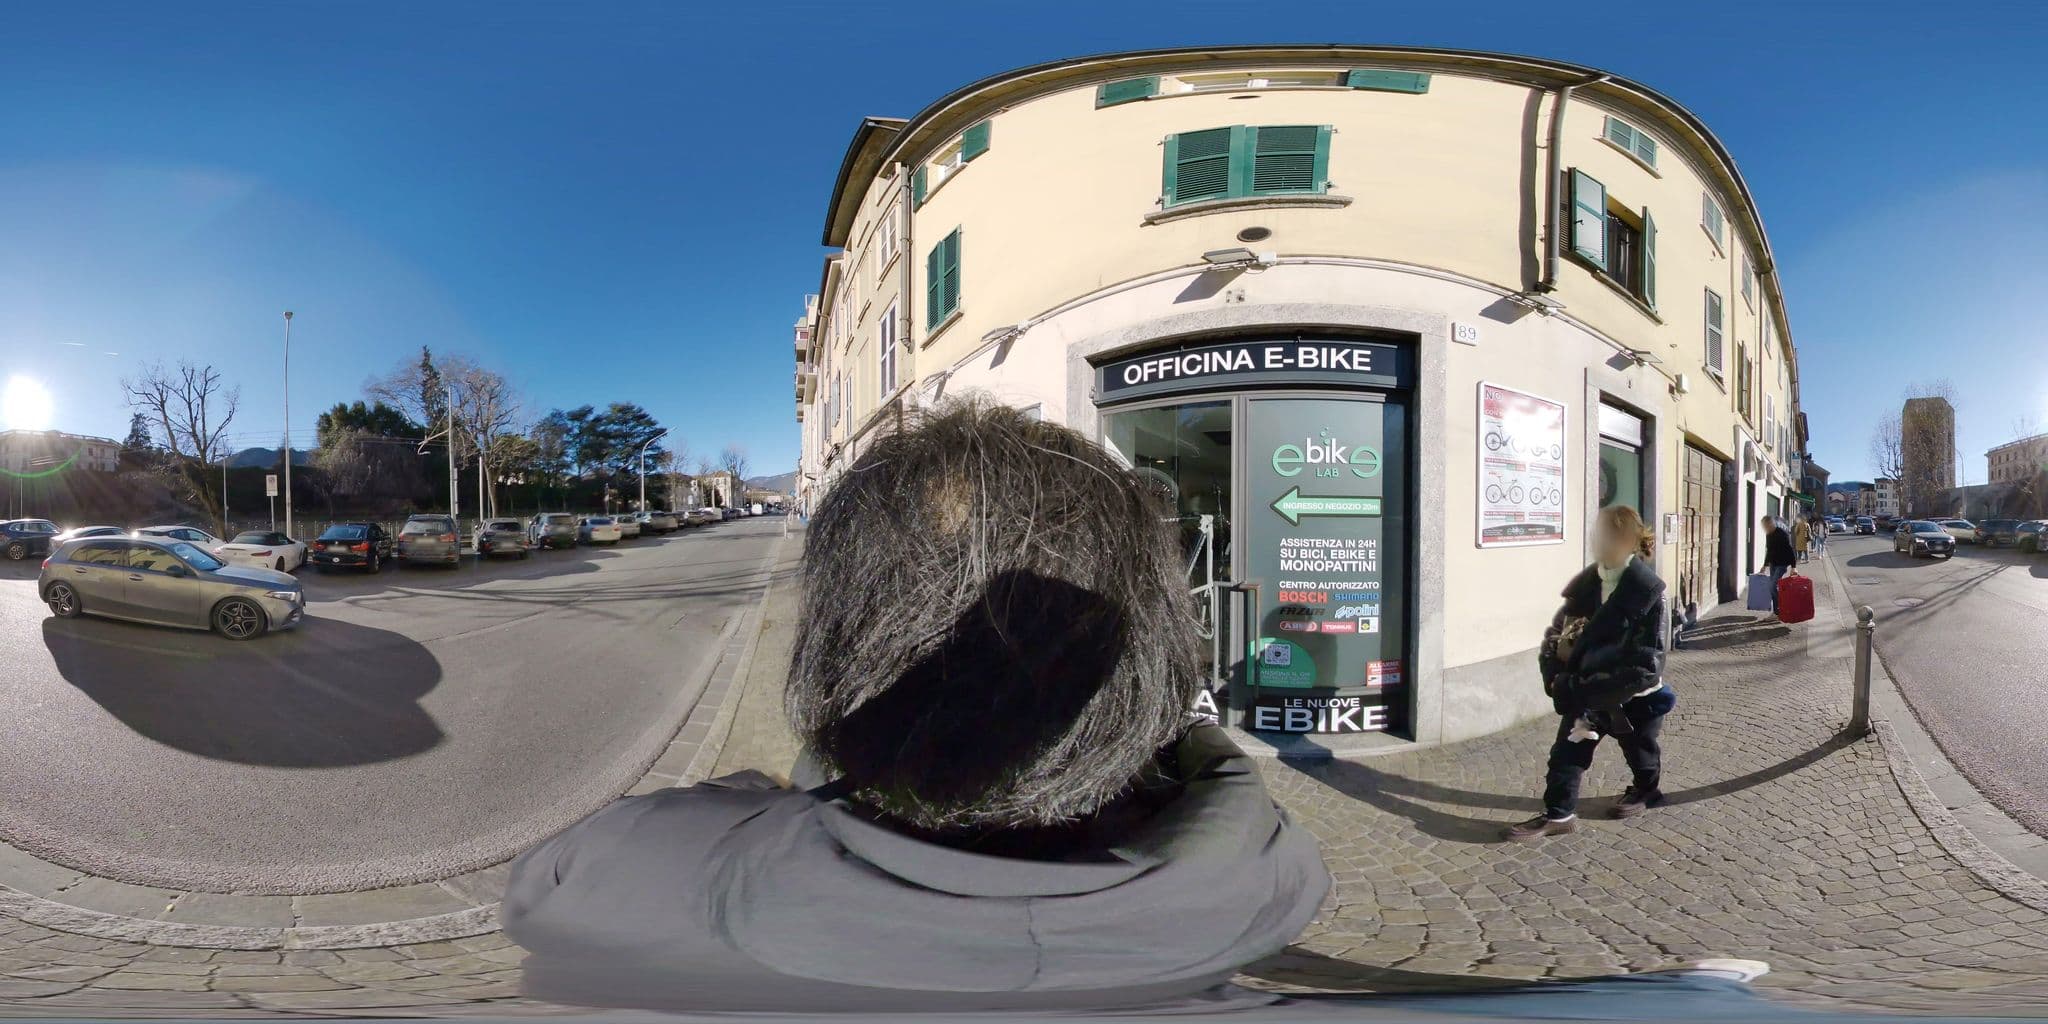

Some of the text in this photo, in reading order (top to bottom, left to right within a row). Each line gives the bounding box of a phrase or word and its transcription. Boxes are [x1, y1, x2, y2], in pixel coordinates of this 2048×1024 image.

[1458, 324, 1477, 341] 89
[1123, 346, 1372, 386] OFFICINA E-BIKE
[1272, 437, 1383, 479] ebike
[1316, 467, 1339, 478] LAB
[1283, 502, 1325, 511] INGRESSO
[1325, 503, 1361, 511] NEGOZIO
[1280, 538, 1376, 548] ASSISTENZA IN 24H
[1280, 549, 1376, 560] SU BICI, EBIKE E
[1280, 560, 1377, 572] MONOPATTINI
[1279, 581, 1380, 590] CENTRO AUTORIZZATO
[1279, 591, 1380, 604] BOSCH SHIMANO
[1284, 698, 1299, 708] LE
[1307, 697, 1361, 708] NUOVE
[1255, 704, 1389, 732] EBIKE
